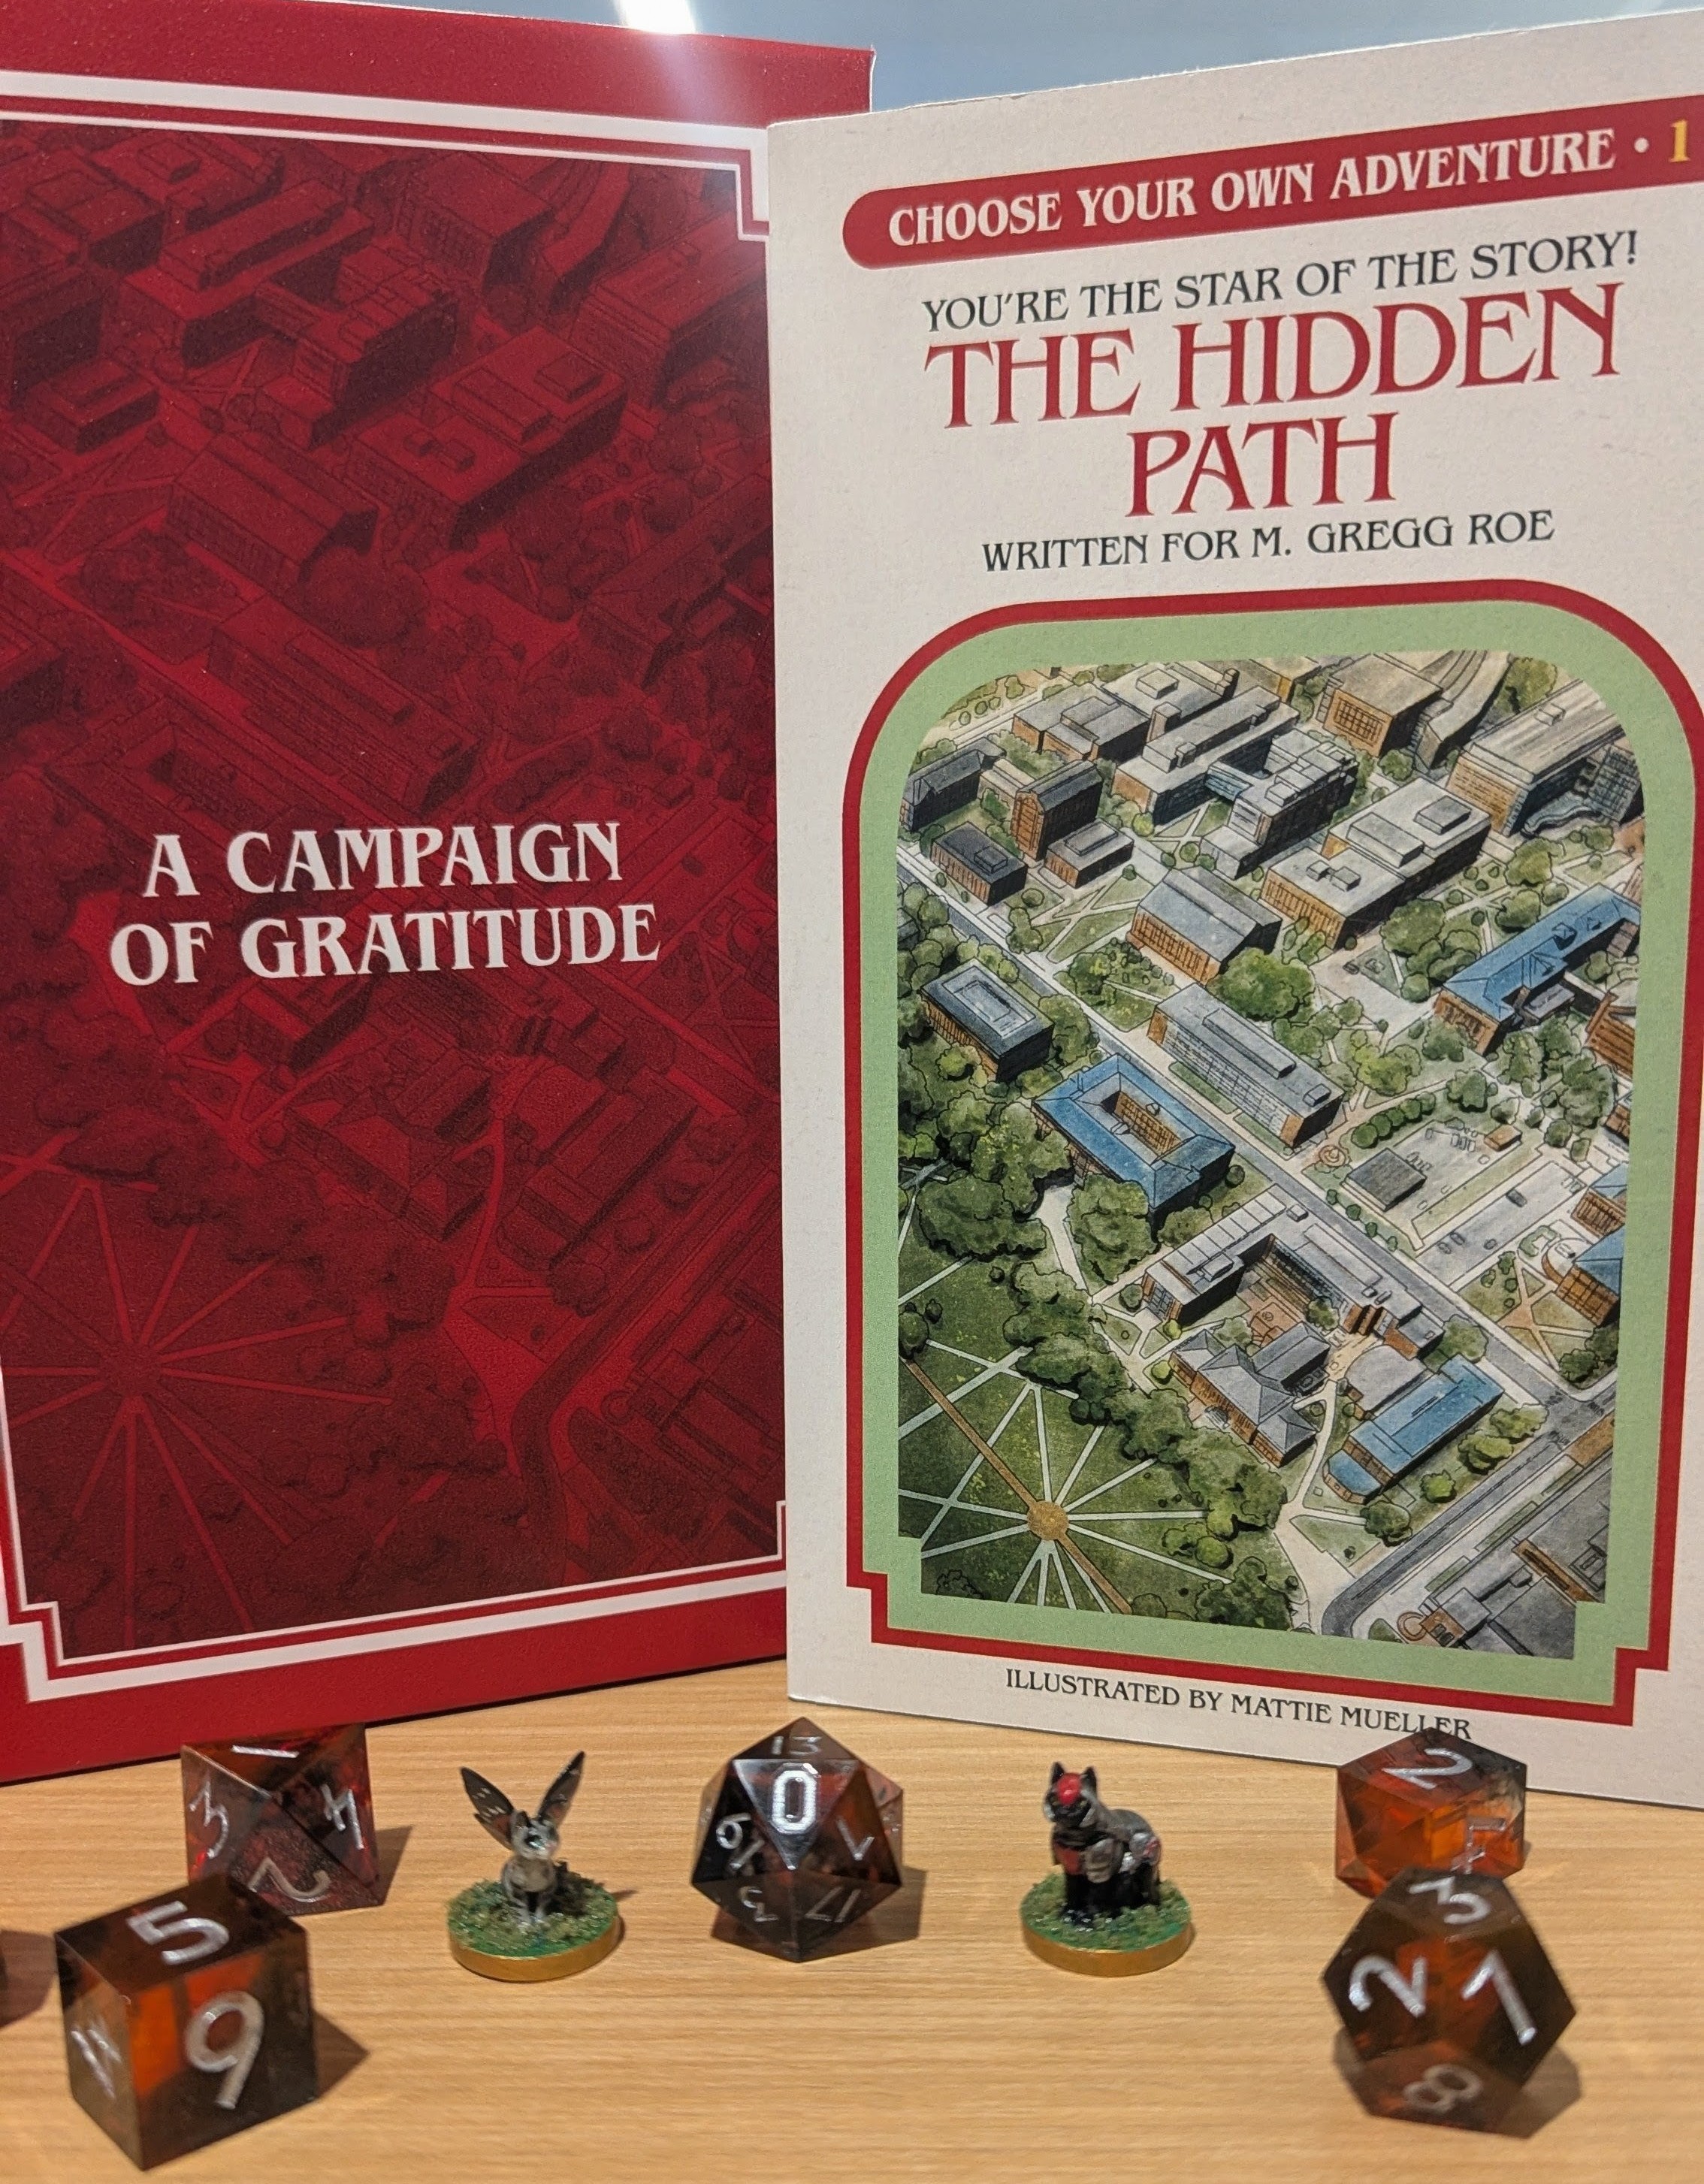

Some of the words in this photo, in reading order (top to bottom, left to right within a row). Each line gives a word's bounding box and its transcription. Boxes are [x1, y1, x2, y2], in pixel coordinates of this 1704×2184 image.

[889, 193, 1062, 247] CHOOSE
[1077, 177, 1197, 227] YOUR
[1210, 163, 1315, 213] OWN
[1329, 128, 1616, 200] ADVENTURE
[1669, 119, 1690, 163] 1
[922, 288, 1069, 332] YOU'RE
[1080, 279, 1164, 319] THE
[1175, 268, 1282, 311] STAR
[1295, 259, 1358, 298] OF
[1368, 249, 1457, 290] THE
[1470, 231, 1639, 279] STORY!
[924, 329, 1143, 429] THE
[1171, 282, 1624, 412] HIDDEN
[1125, 412, 1400, 517] PATH
[981, 534, 1149, 572] WRITTEN
[1160, 526, 1243, 561] FOR
[1251, 527, 1292, 558] M.
[1307, 517, 1454, 554] GREGG
[1467, 509, 1554, 543] ROE
[143, 834, 199, 898] A
[226, 822, 623, 893] CAMPAIGN
[110, 922, 214, 986] OF
[239, 904, 661, 980] GRATITUDE
[1005, 1668, 1180, 1705] ILLUSTRATED
[1189, 1690, 1222, 1710] BY
[1231, 1694, 1331, 1723] MATTIE
[1341, 1706, 1472, 1740] MUELLER
[772, 1769, 817, 1835] 0
[1383, 1748, 1473, 1790] 2
[126, 1901, 230, 1965] 5
[1348, 1953, 1427, 2018] 2
